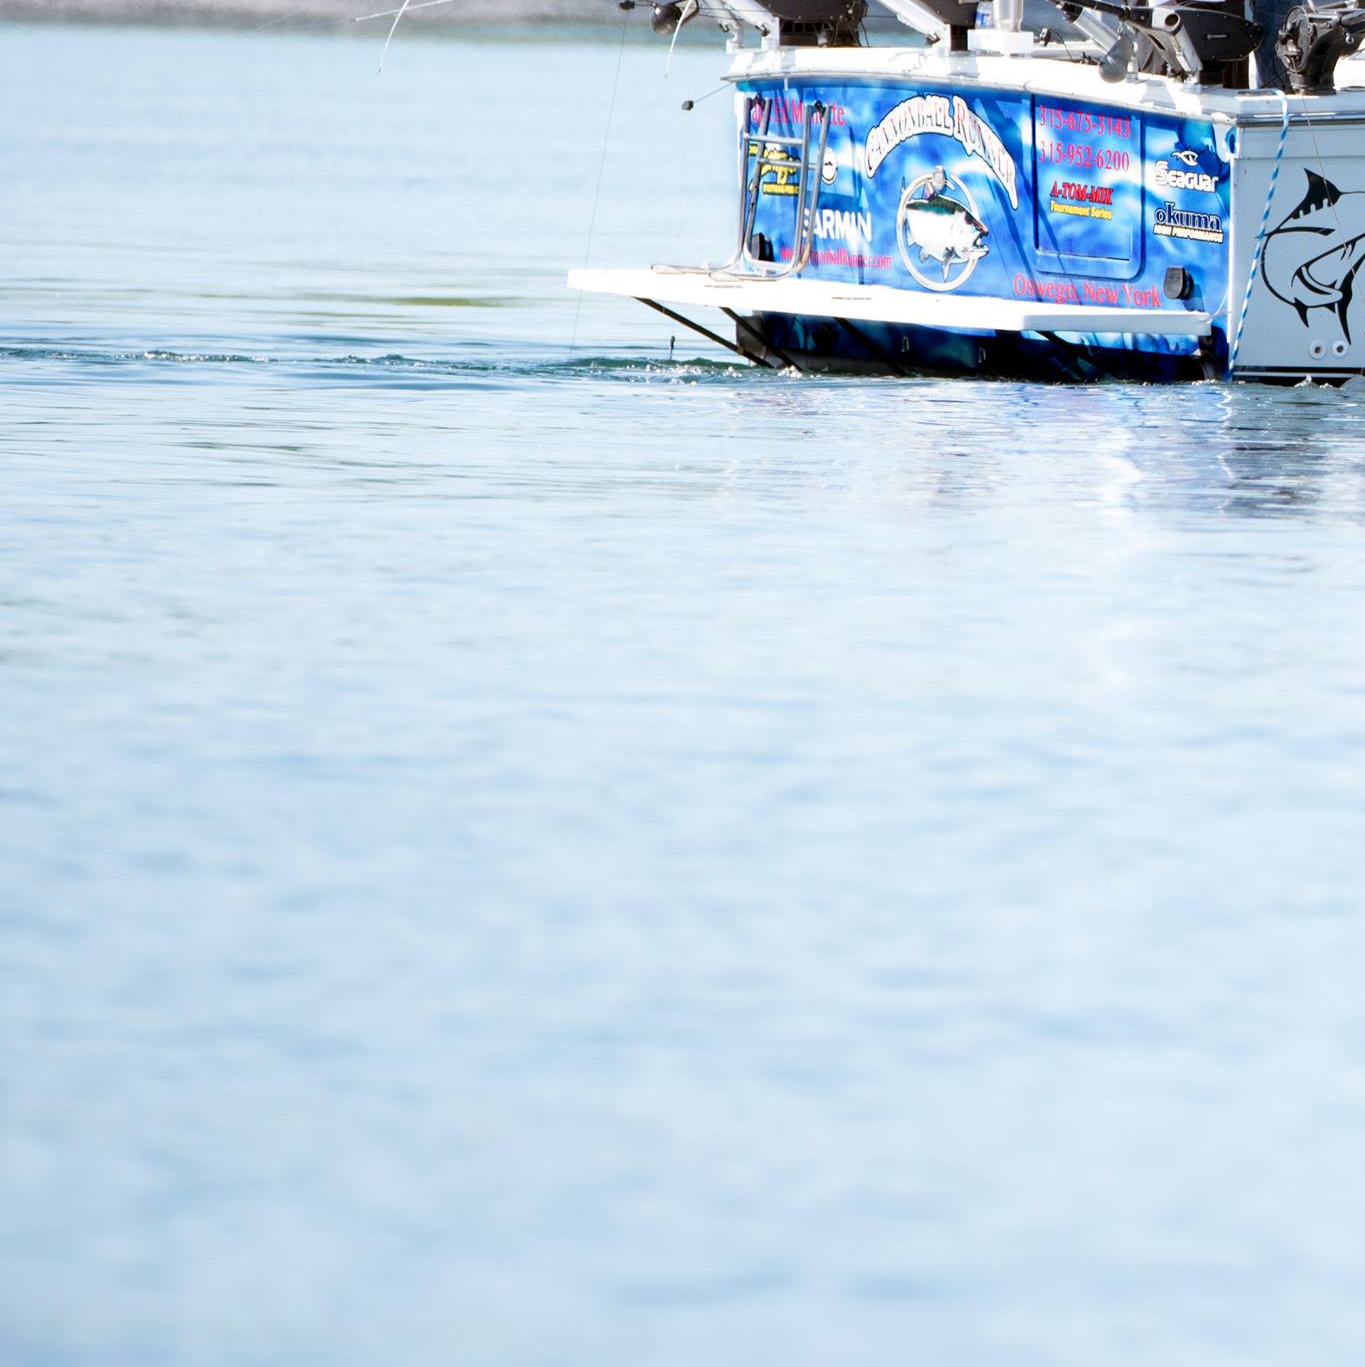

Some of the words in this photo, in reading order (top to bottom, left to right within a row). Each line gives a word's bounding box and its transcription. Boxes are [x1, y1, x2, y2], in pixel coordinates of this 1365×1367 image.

[1040, 105, 1131, 138] 315-675-3143
[1039, 140, 1131, 172] 315-952-6200
[1154, 202, 1223, 232] okuma
[1084, 280, 1118, 304] New
[1122, 283, 1161, 308] York
